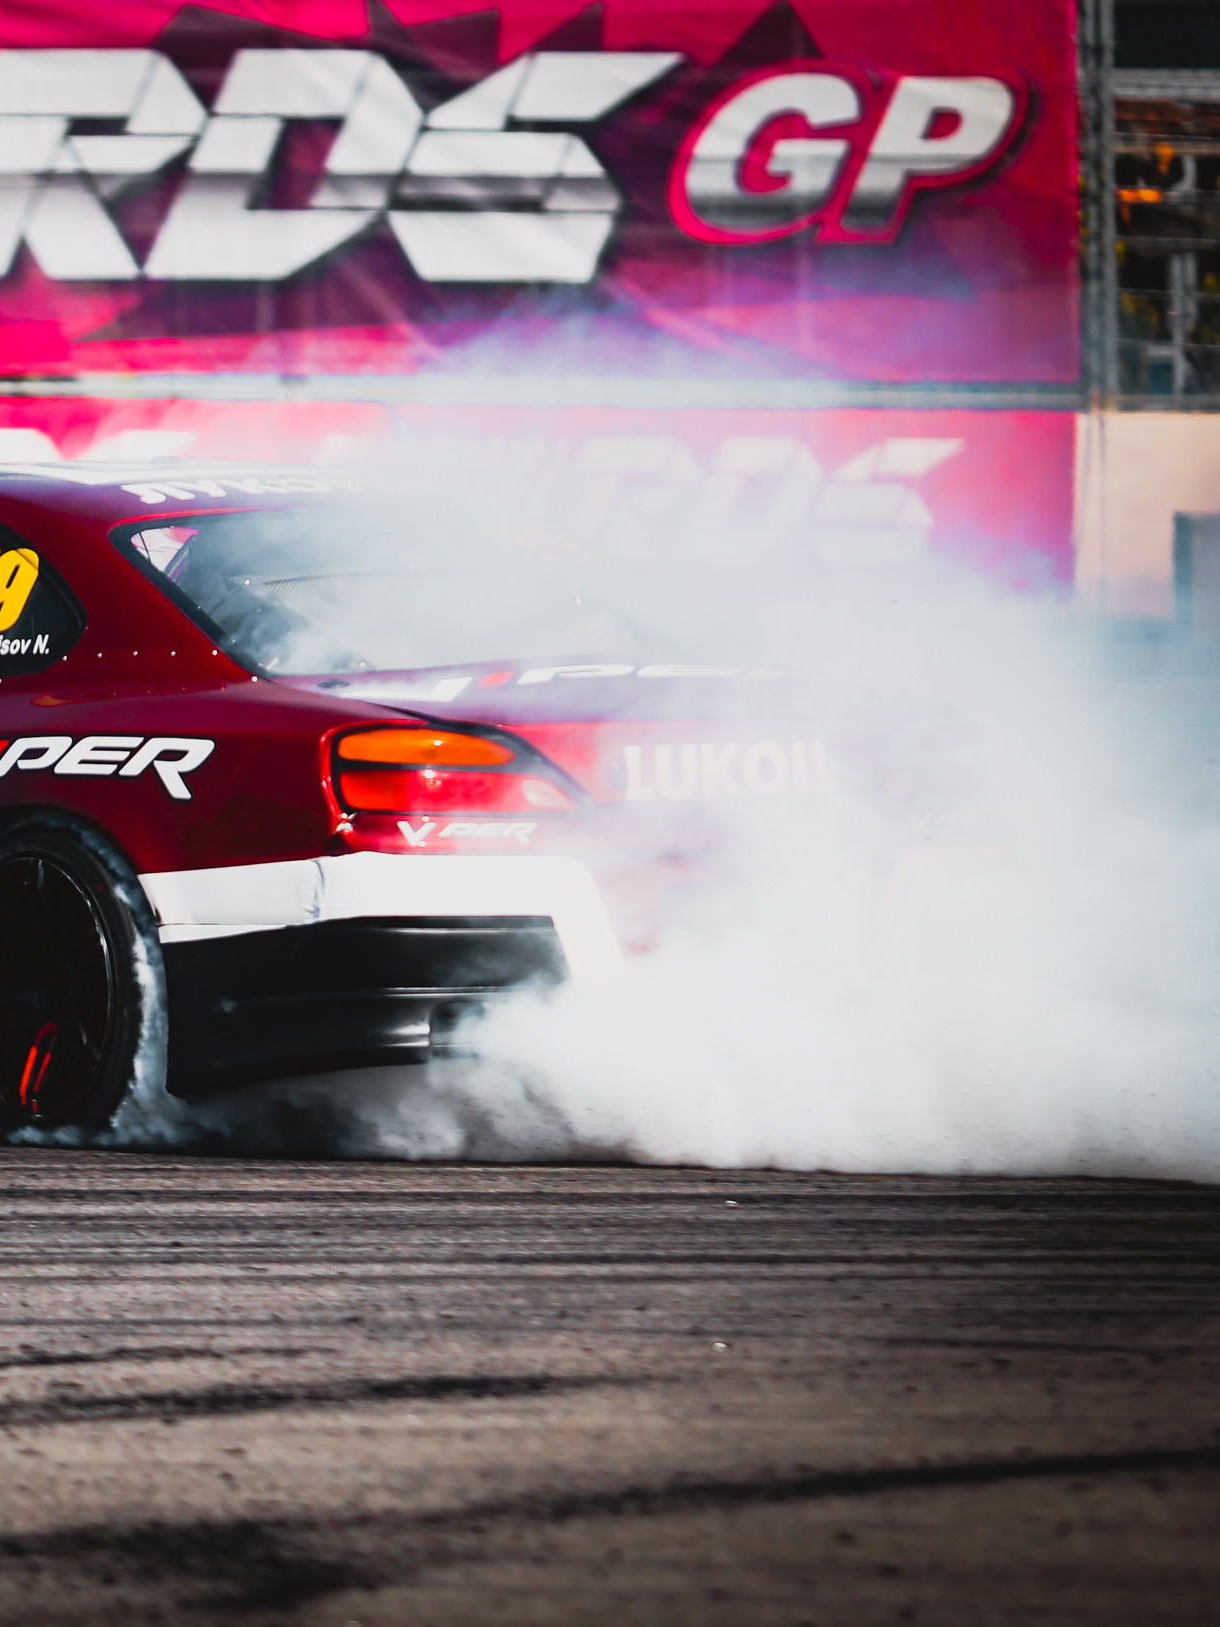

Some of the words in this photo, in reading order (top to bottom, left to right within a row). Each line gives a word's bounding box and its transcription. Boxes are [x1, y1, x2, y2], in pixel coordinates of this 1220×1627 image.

[682, 71, 1016, 238] GP
[32, 634, 50, 655] N.
[396, 820, 538, 847] VPER
